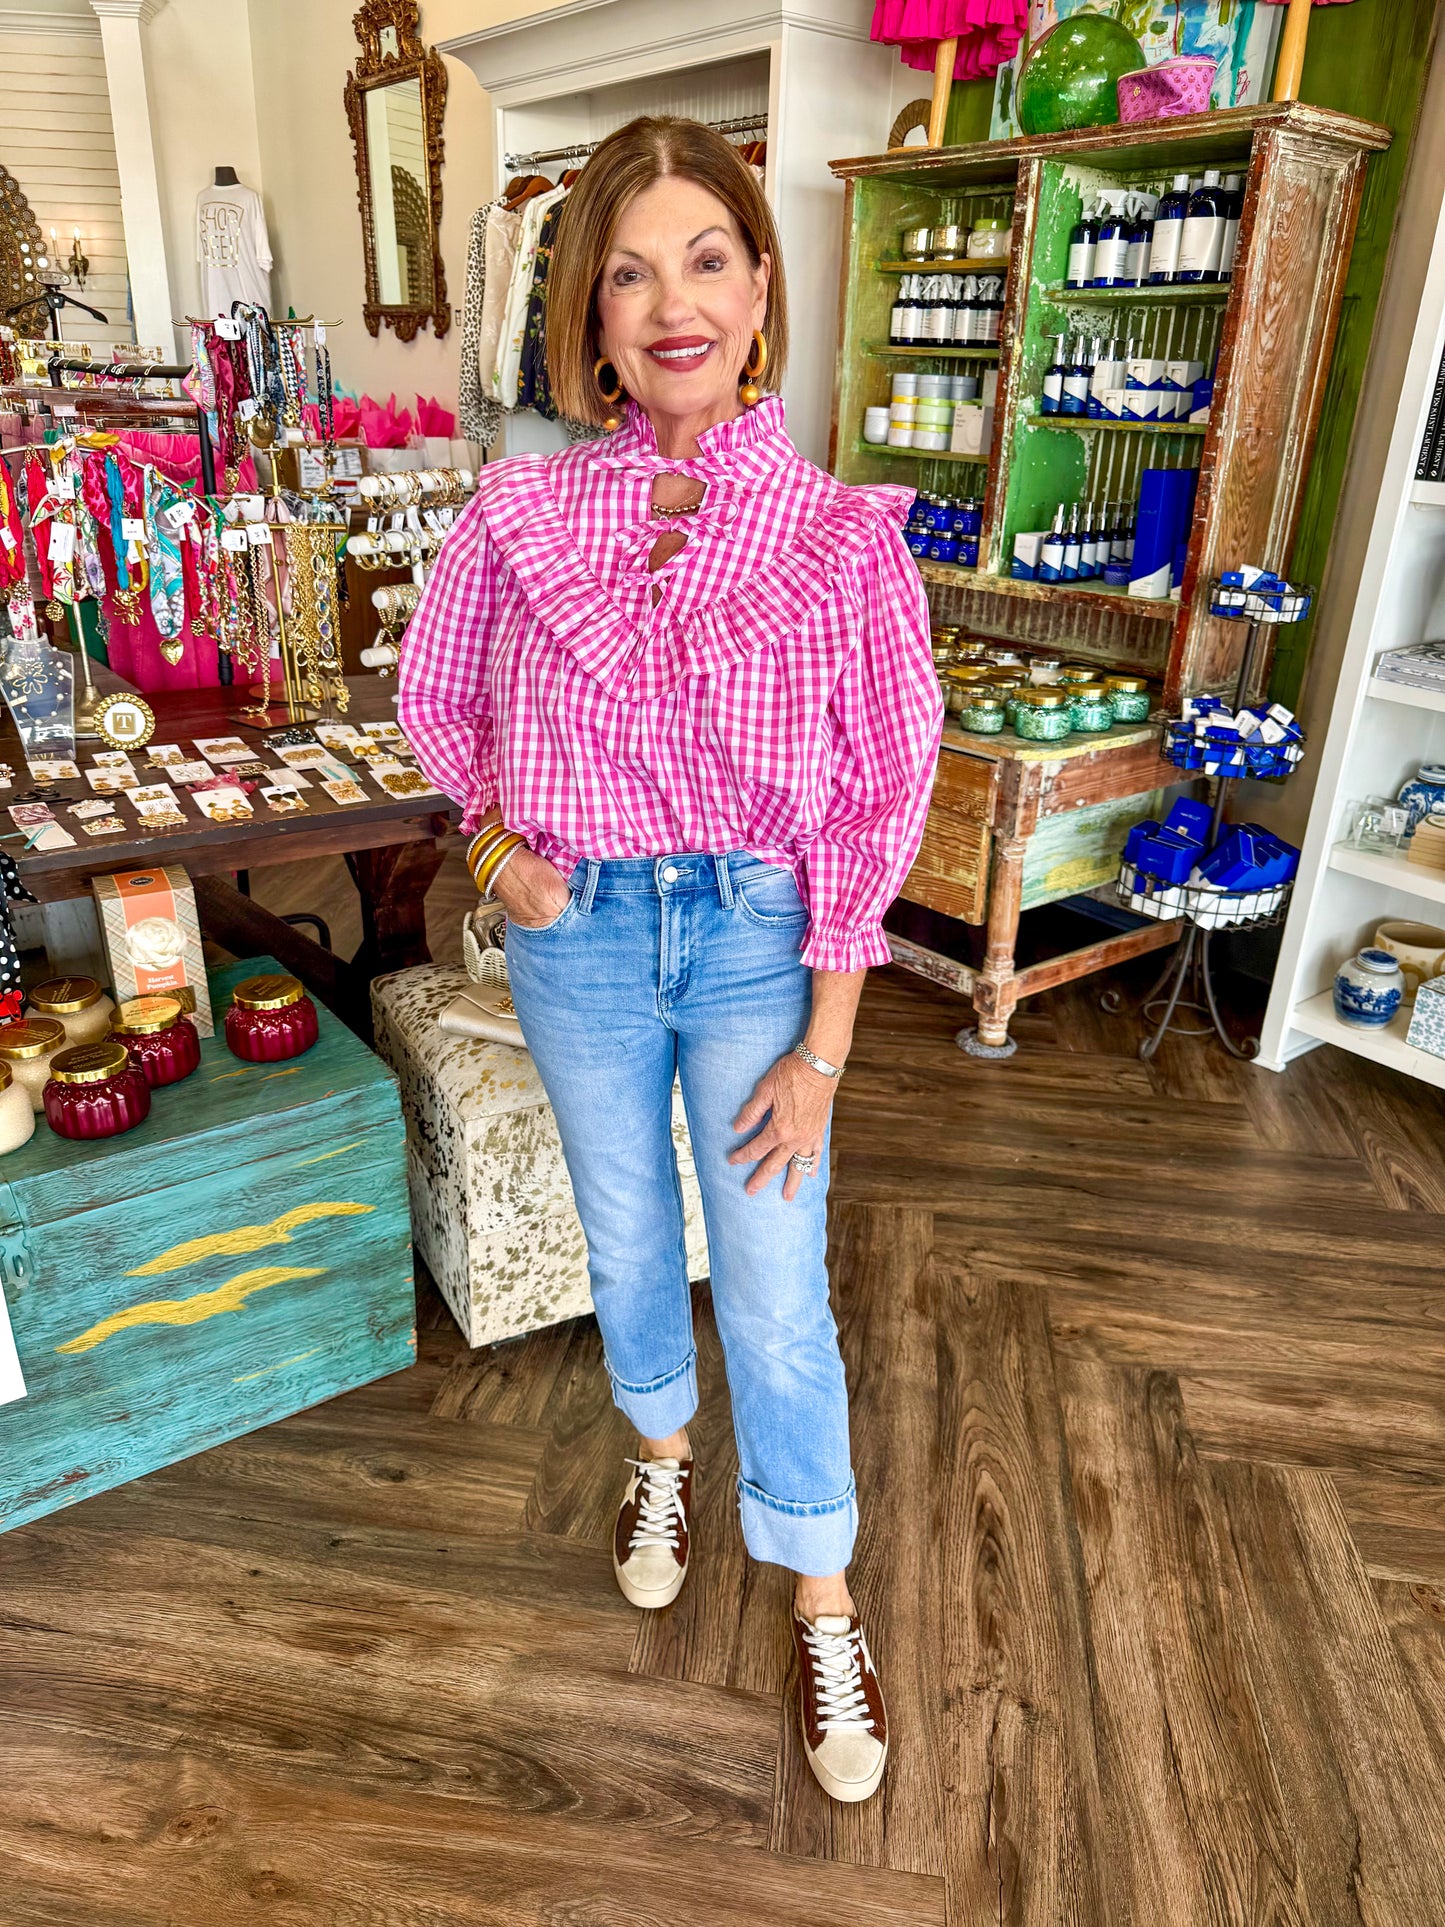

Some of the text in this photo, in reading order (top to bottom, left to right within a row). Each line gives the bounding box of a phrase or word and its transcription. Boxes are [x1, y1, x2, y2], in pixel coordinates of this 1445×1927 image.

[1433, 387, 1443, 407] YVES
[1427, 407, 1438, 431] SAINT
[1419, 432, 1433, 467] LAURENT
[1433, 433, 1445, 469] LAURENT
[116, 714, 132, 728] T
[147, 981, 177, 990] Pumpkin
[148, 975, 174, 983] Harvest
